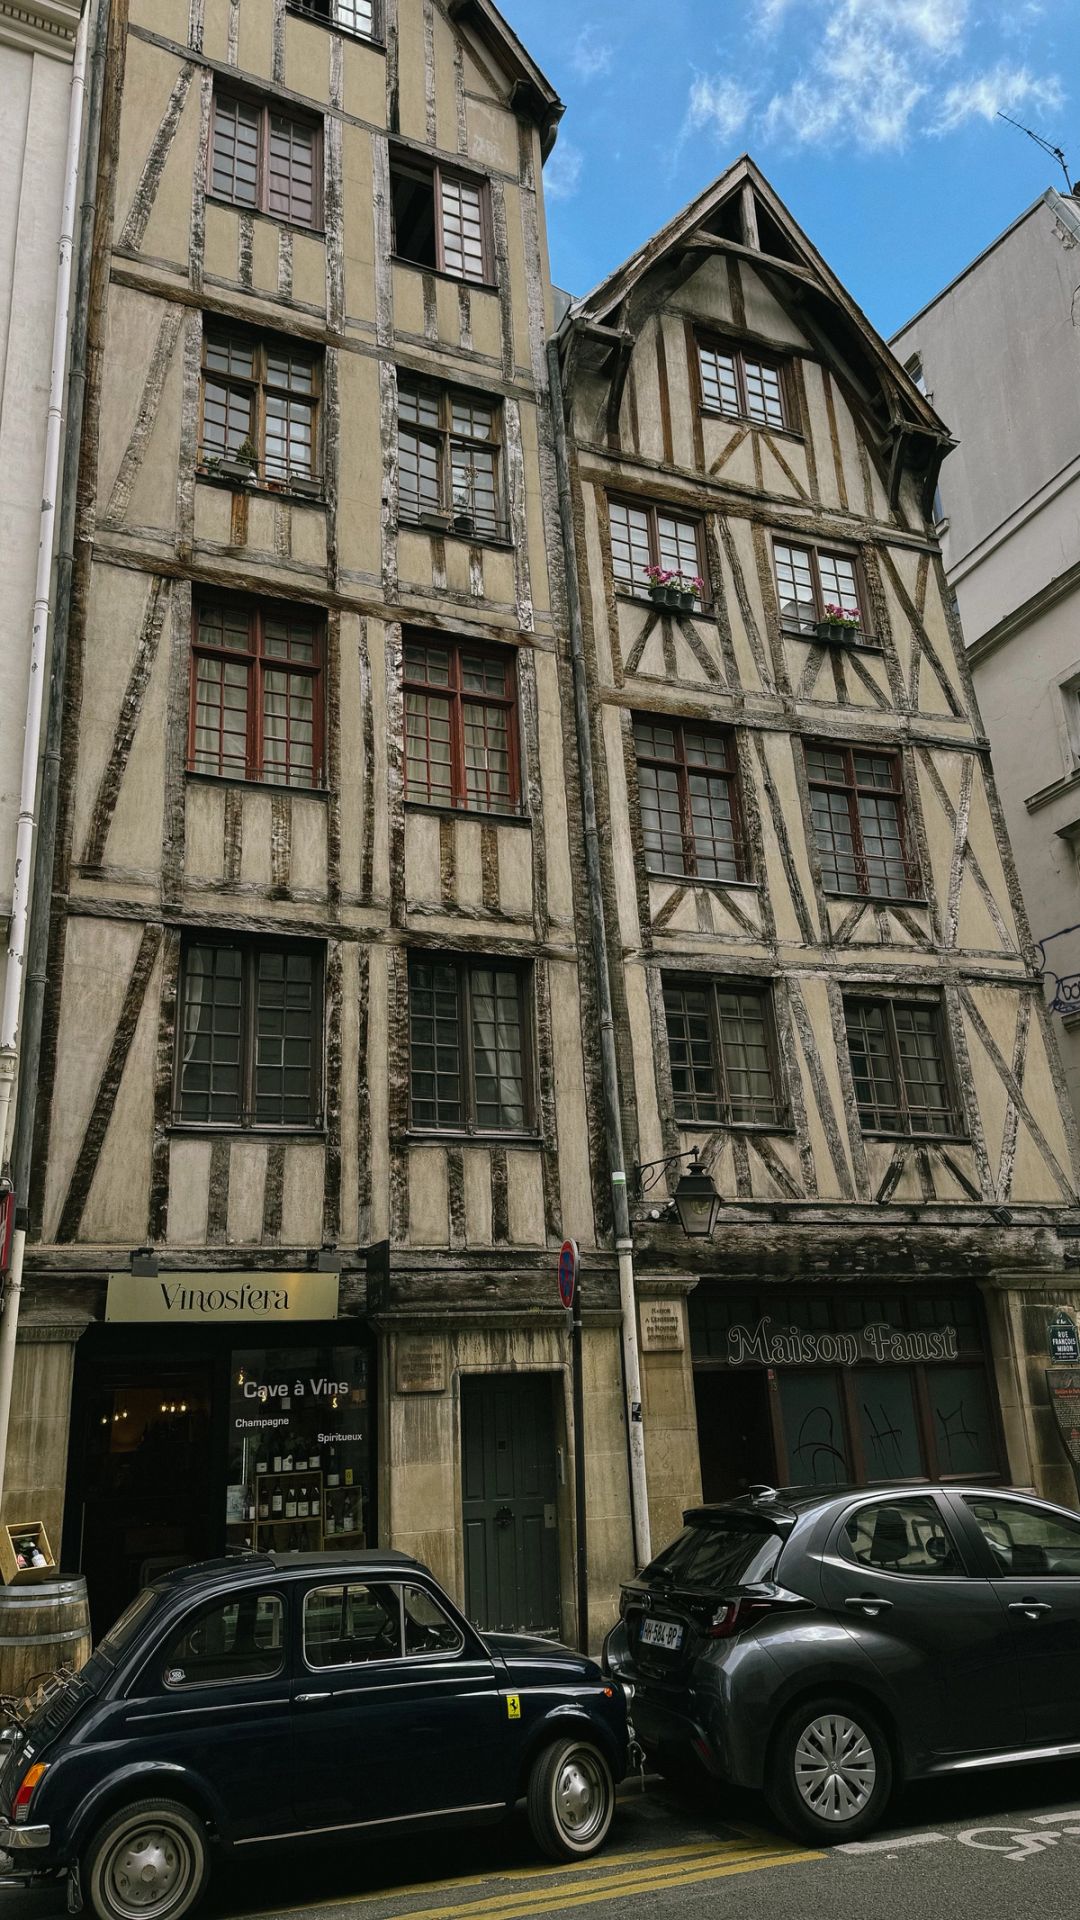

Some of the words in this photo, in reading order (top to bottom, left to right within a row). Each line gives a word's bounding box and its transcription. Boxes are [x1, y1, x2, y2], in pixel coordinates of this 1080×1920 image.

[160, 1282, 290, 1315] Vinosfera
[728, 1316, 858, 1364] Maison
[863, 1323, 958, 1360] Faust
[244, 1382, 289, 1399] Cave
[293, 1380, 305, 1396] à
[309, 1379, 349, 1395] Vins
[235, 1418, 289, 1428] Champagne
[317, 1433, 362, 1443] Spiritueux
